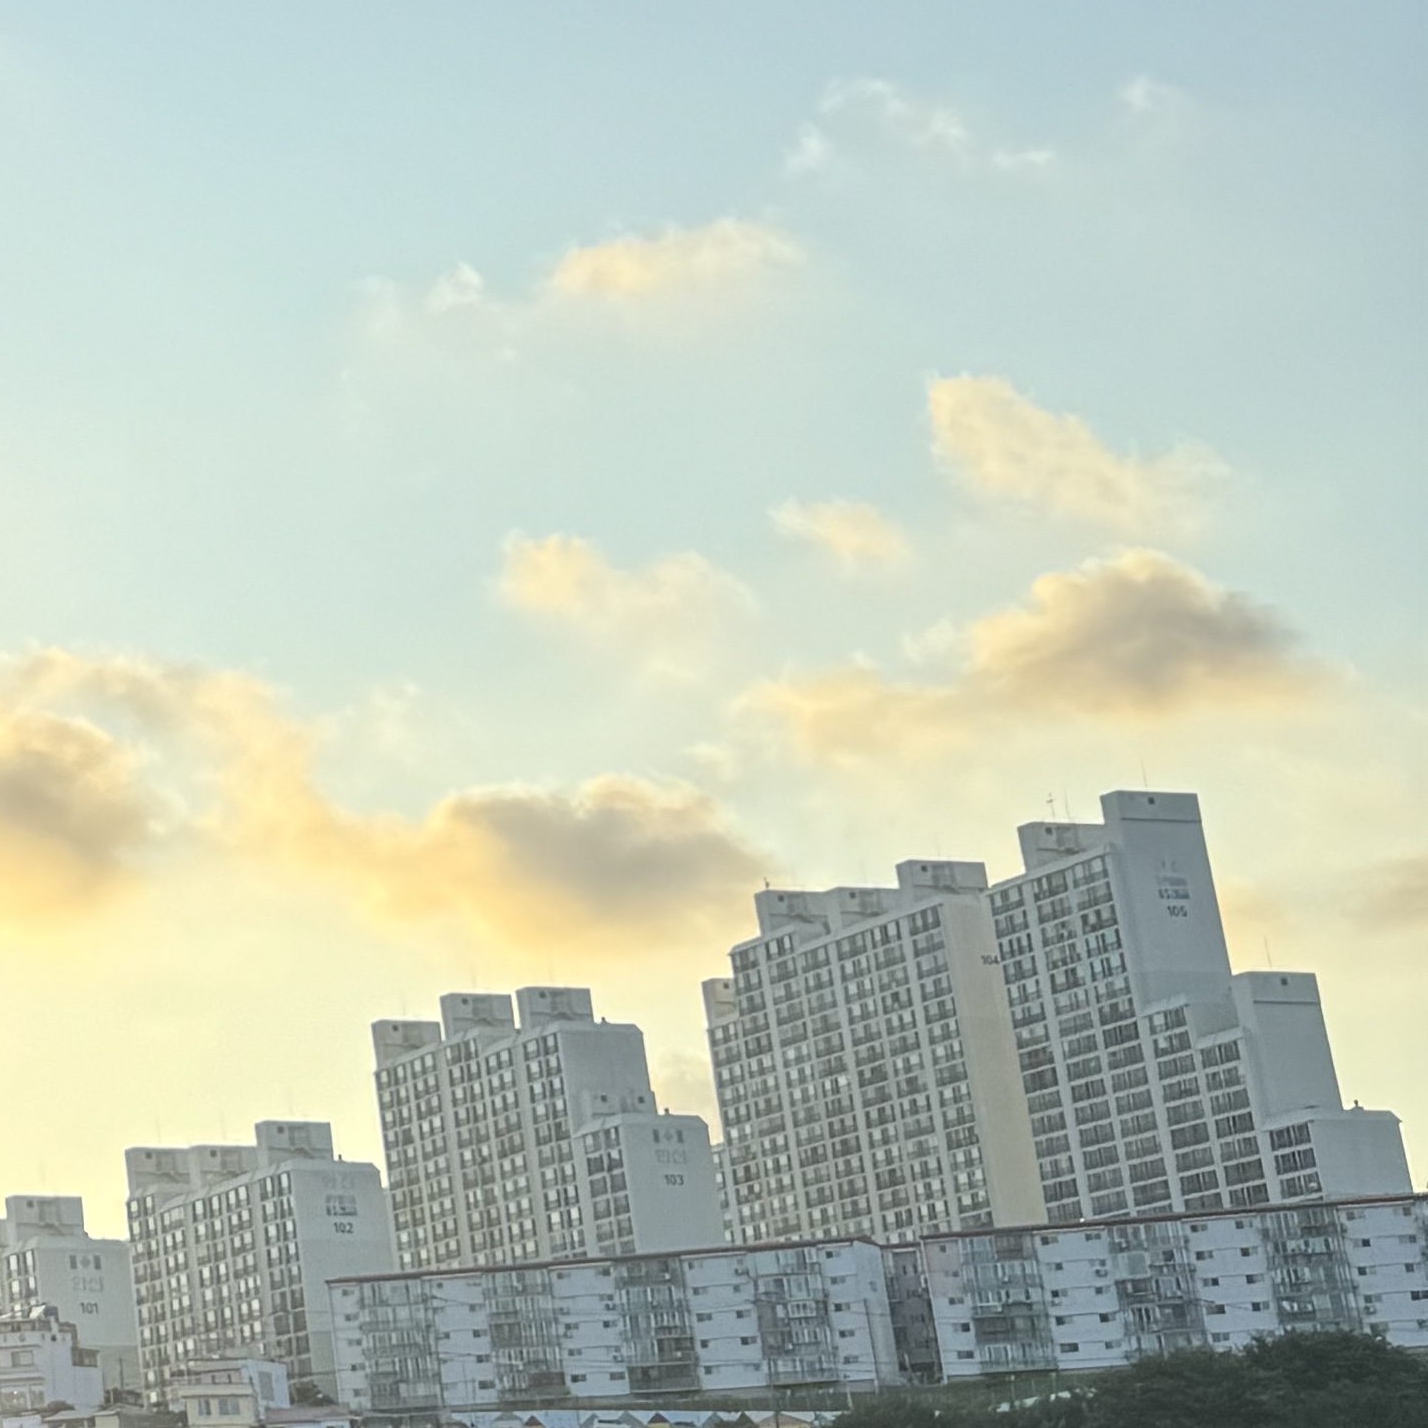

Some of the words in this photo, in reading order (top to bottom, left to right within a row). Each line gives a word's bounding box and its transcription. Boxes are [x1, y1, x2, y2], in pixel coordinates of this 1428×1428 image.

[665, 1174, 684, 1186] 103
[334, 1222, 354, 1233] 102
[81, 1302, 99, 1314] 101
